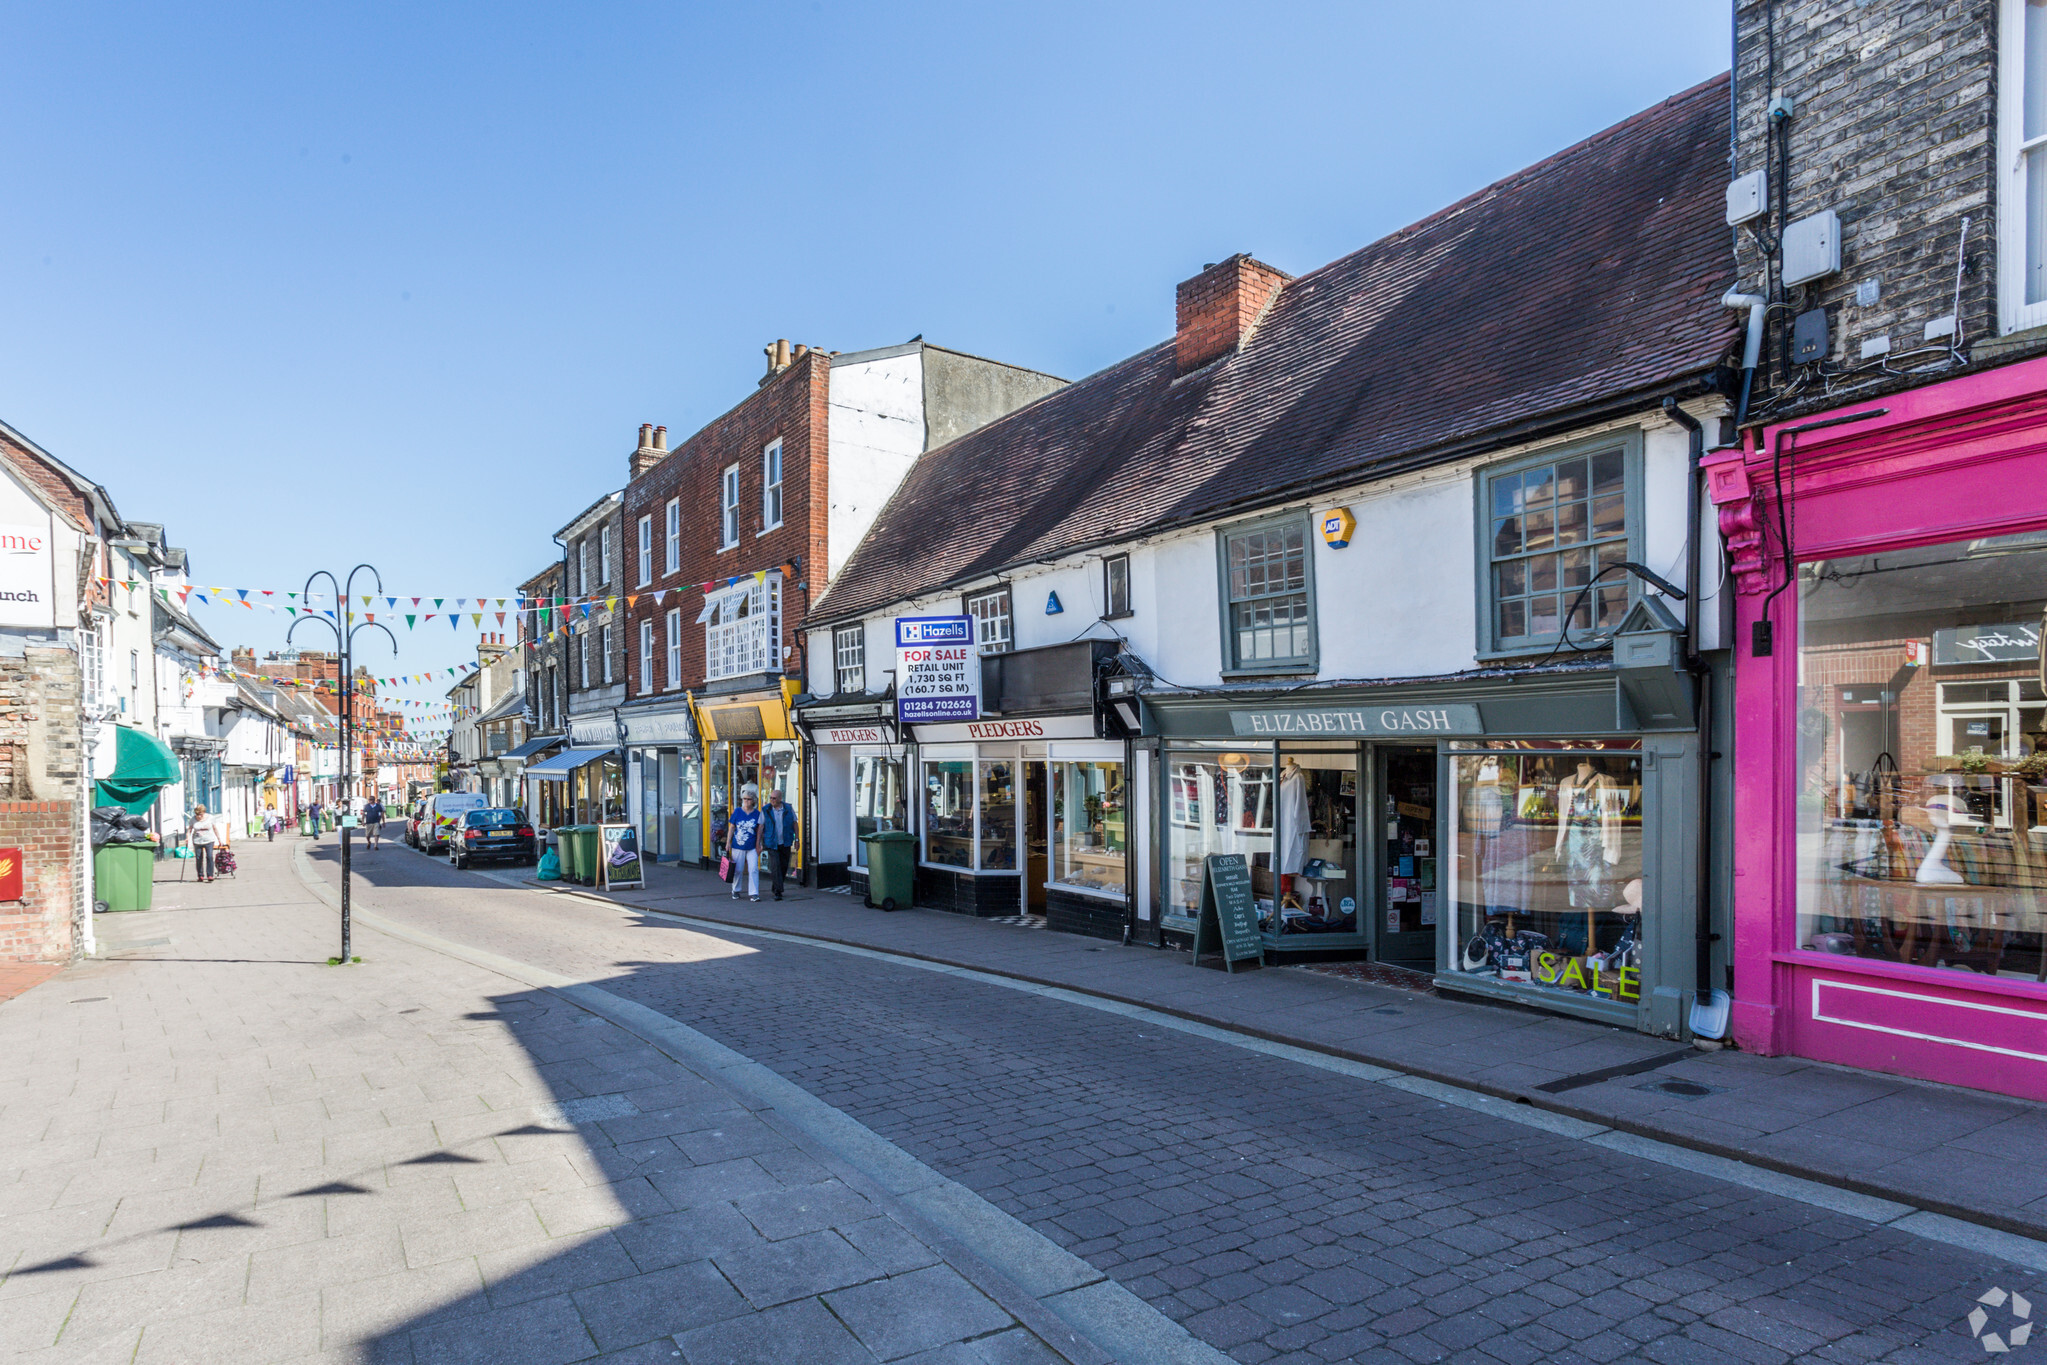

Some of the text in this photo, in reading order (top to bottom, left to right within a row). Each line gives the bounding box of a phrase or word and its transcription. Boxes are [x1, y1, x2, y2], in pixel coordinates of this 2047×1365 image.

[1326, 520, 1340, 531] ADT
[923, 624, 964, 637] Hazells
[904, 649, 967, 662] FOR SALE
[908, 662, 964, 673] RETAIL UNIT
[909, 673, 965, 684] 1,730 SQ FT
[905, 684, 969, 696] (160.7 SQ M)
[904, 700, 972, 711] 01284 702626
[904, 709, 972, 718] hazellsonline.co.uk
[1250, 709, 1452, 732] ELIZABETH GASH
[968, 720, 1044, 738] PLEDGERS
[830, 729, 878, 742] PLEDGERS
[1219, 856, 1239, 866] OPEN
[1539, 952, 1640, 999] SALE
